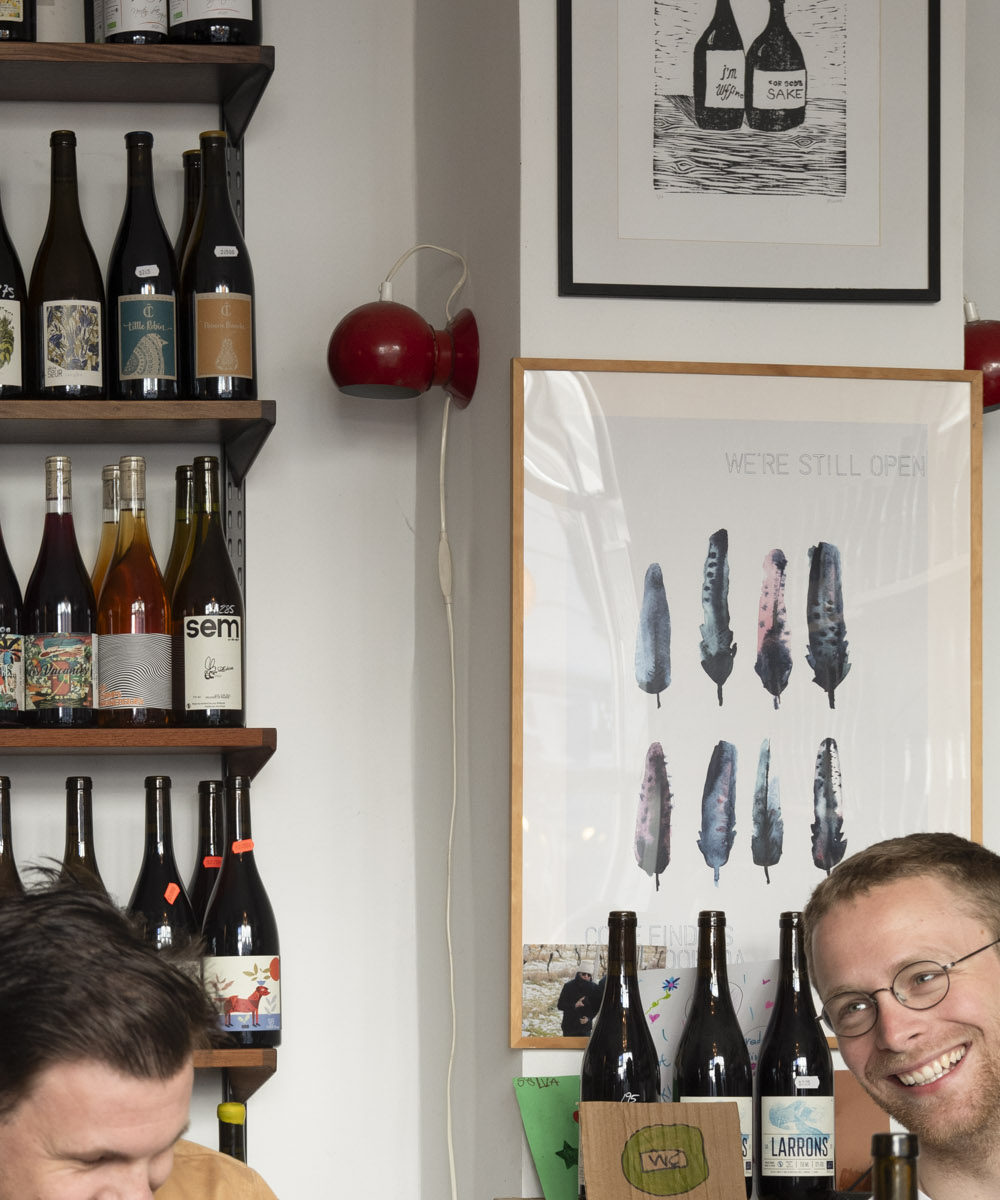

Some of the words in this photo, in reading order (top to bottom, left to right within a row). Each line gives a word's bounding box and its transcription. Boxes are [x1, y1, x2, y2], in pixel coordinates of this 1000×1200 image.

[767, 88, 804, 99] SAKE
[725, 452, 789, 475] WE'RE
[799, 453, 861, 476] STILL
[870, 454, 926, 477] OPEN
[186, 618, 240, 639] sem
[771, 1136, 828, 1157] LARRONS
